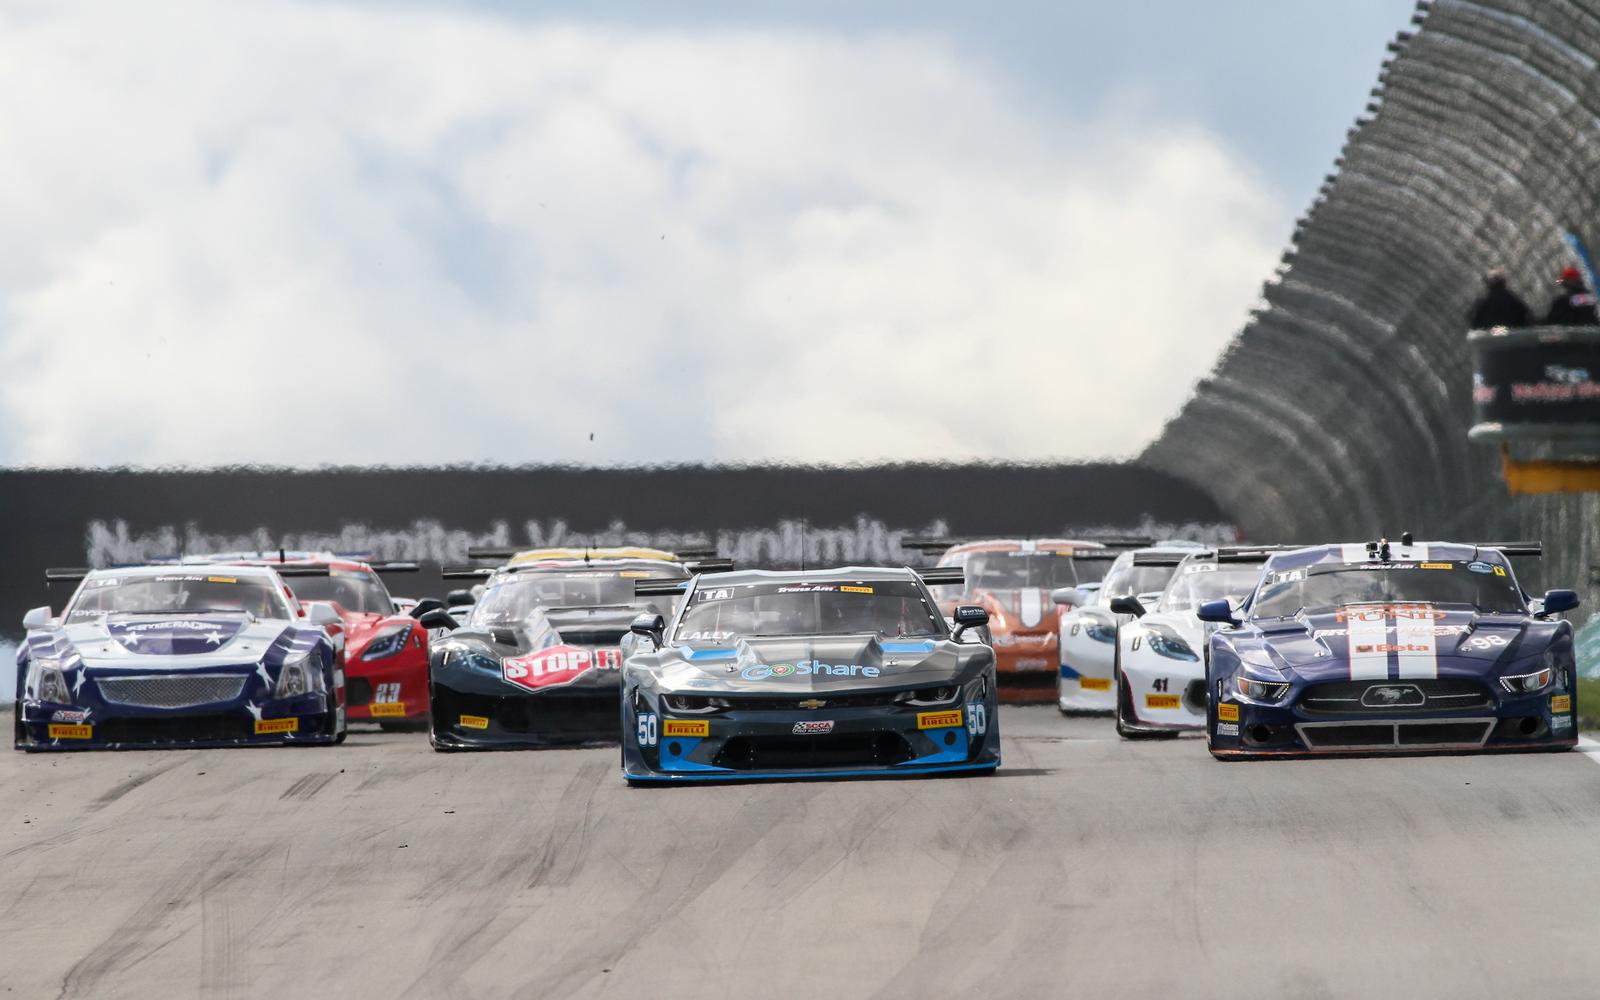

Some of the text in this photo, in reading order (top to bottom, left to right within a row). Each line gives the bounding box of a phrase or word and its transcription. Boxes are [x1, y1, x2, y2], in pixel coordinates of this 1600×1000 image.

[1279, 571, 1301, 582] TA
[703, 589, 728, 600] TA
[678, 631, 736, 641] LALLY
[1470, 634, 1507, 650] 98
[1376, 643, 1430, 652] Beta
[505, 651, 590, 679] STOP
[1152, 677, 1169, 692] 41
[921, 713, 959, 726] PIRELLI
[967, 703, 986, 736] 50
[638, 714, 657, 746] 50
[667, 723, 706, 734] PIRELLI
